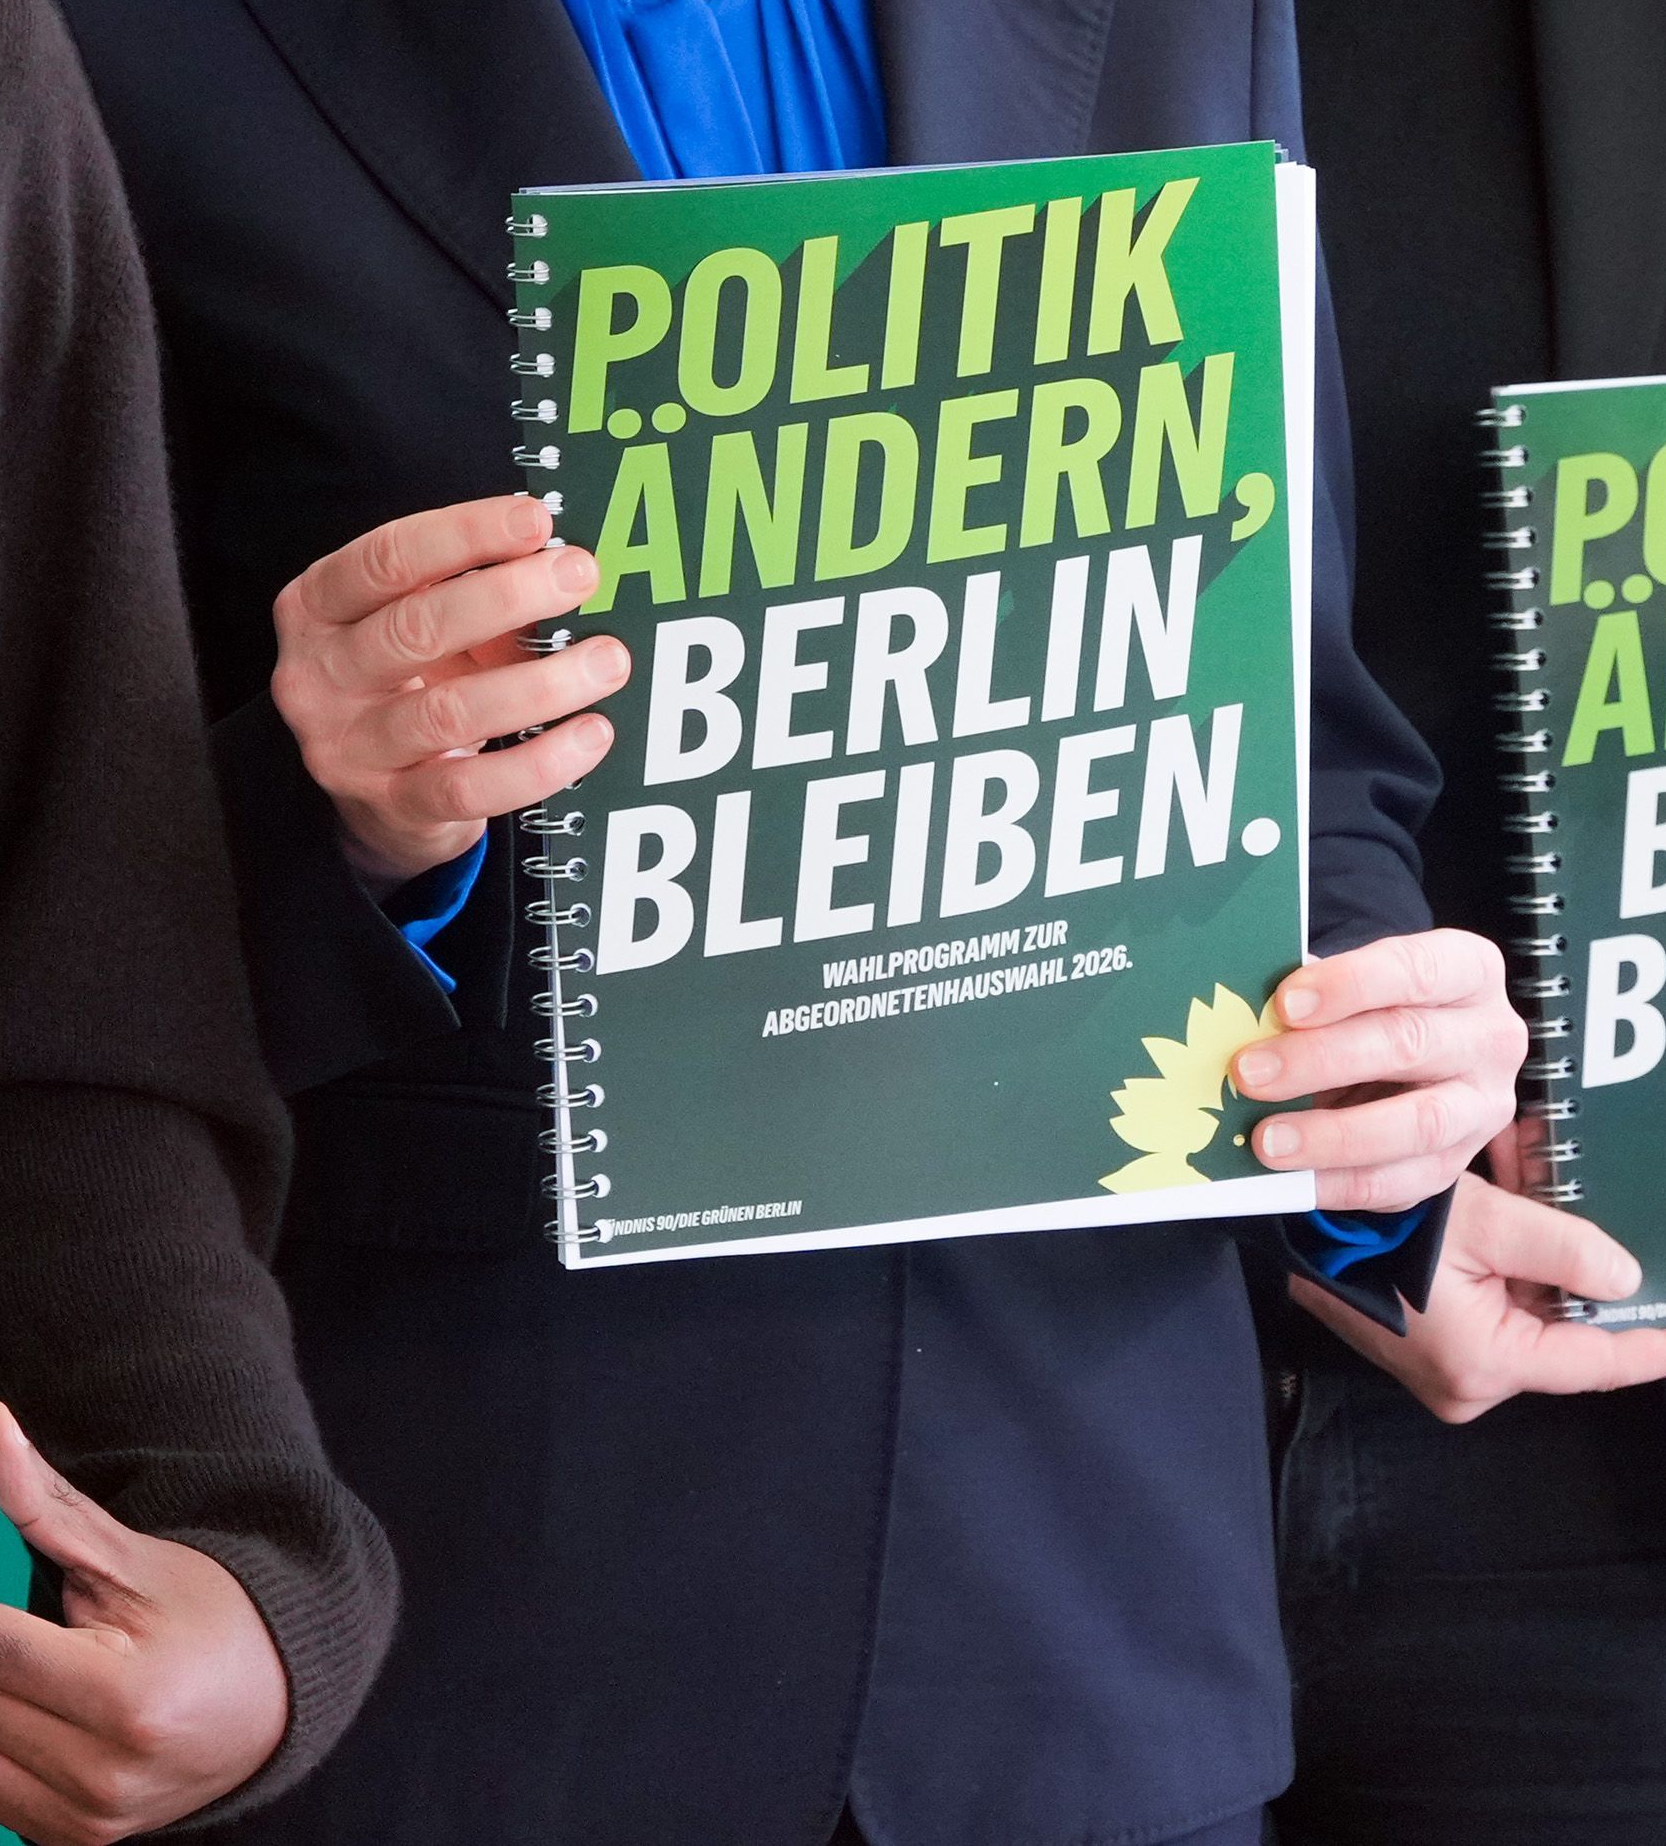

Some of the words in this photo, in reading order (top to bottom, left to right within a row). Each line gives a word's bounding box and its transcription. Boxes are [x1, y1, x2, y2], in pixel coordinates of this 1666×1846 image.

[568, 178, 1200, 435] POLITIK
[580, 351, 1275, 614] ÄNDERN,
[643, 535, 1201, 785] BERLIN
[595, 703, 1282, 975] BLEIBEN.
[822, 927, 1020, 989] WAHLPROGRAMM
[1023, 920, 1069, 951] ZUR
[762, 962, 1068, 1038] ABGEORDNETENHAUSWAHL
[1071, 944, 1134, 981] 2026.
[656, 1211, 701, 1233] 90/DIE
[701, 1205, 755, 1227] GRÜNEN
[756, 1200, 802, 1219] BERLIN
